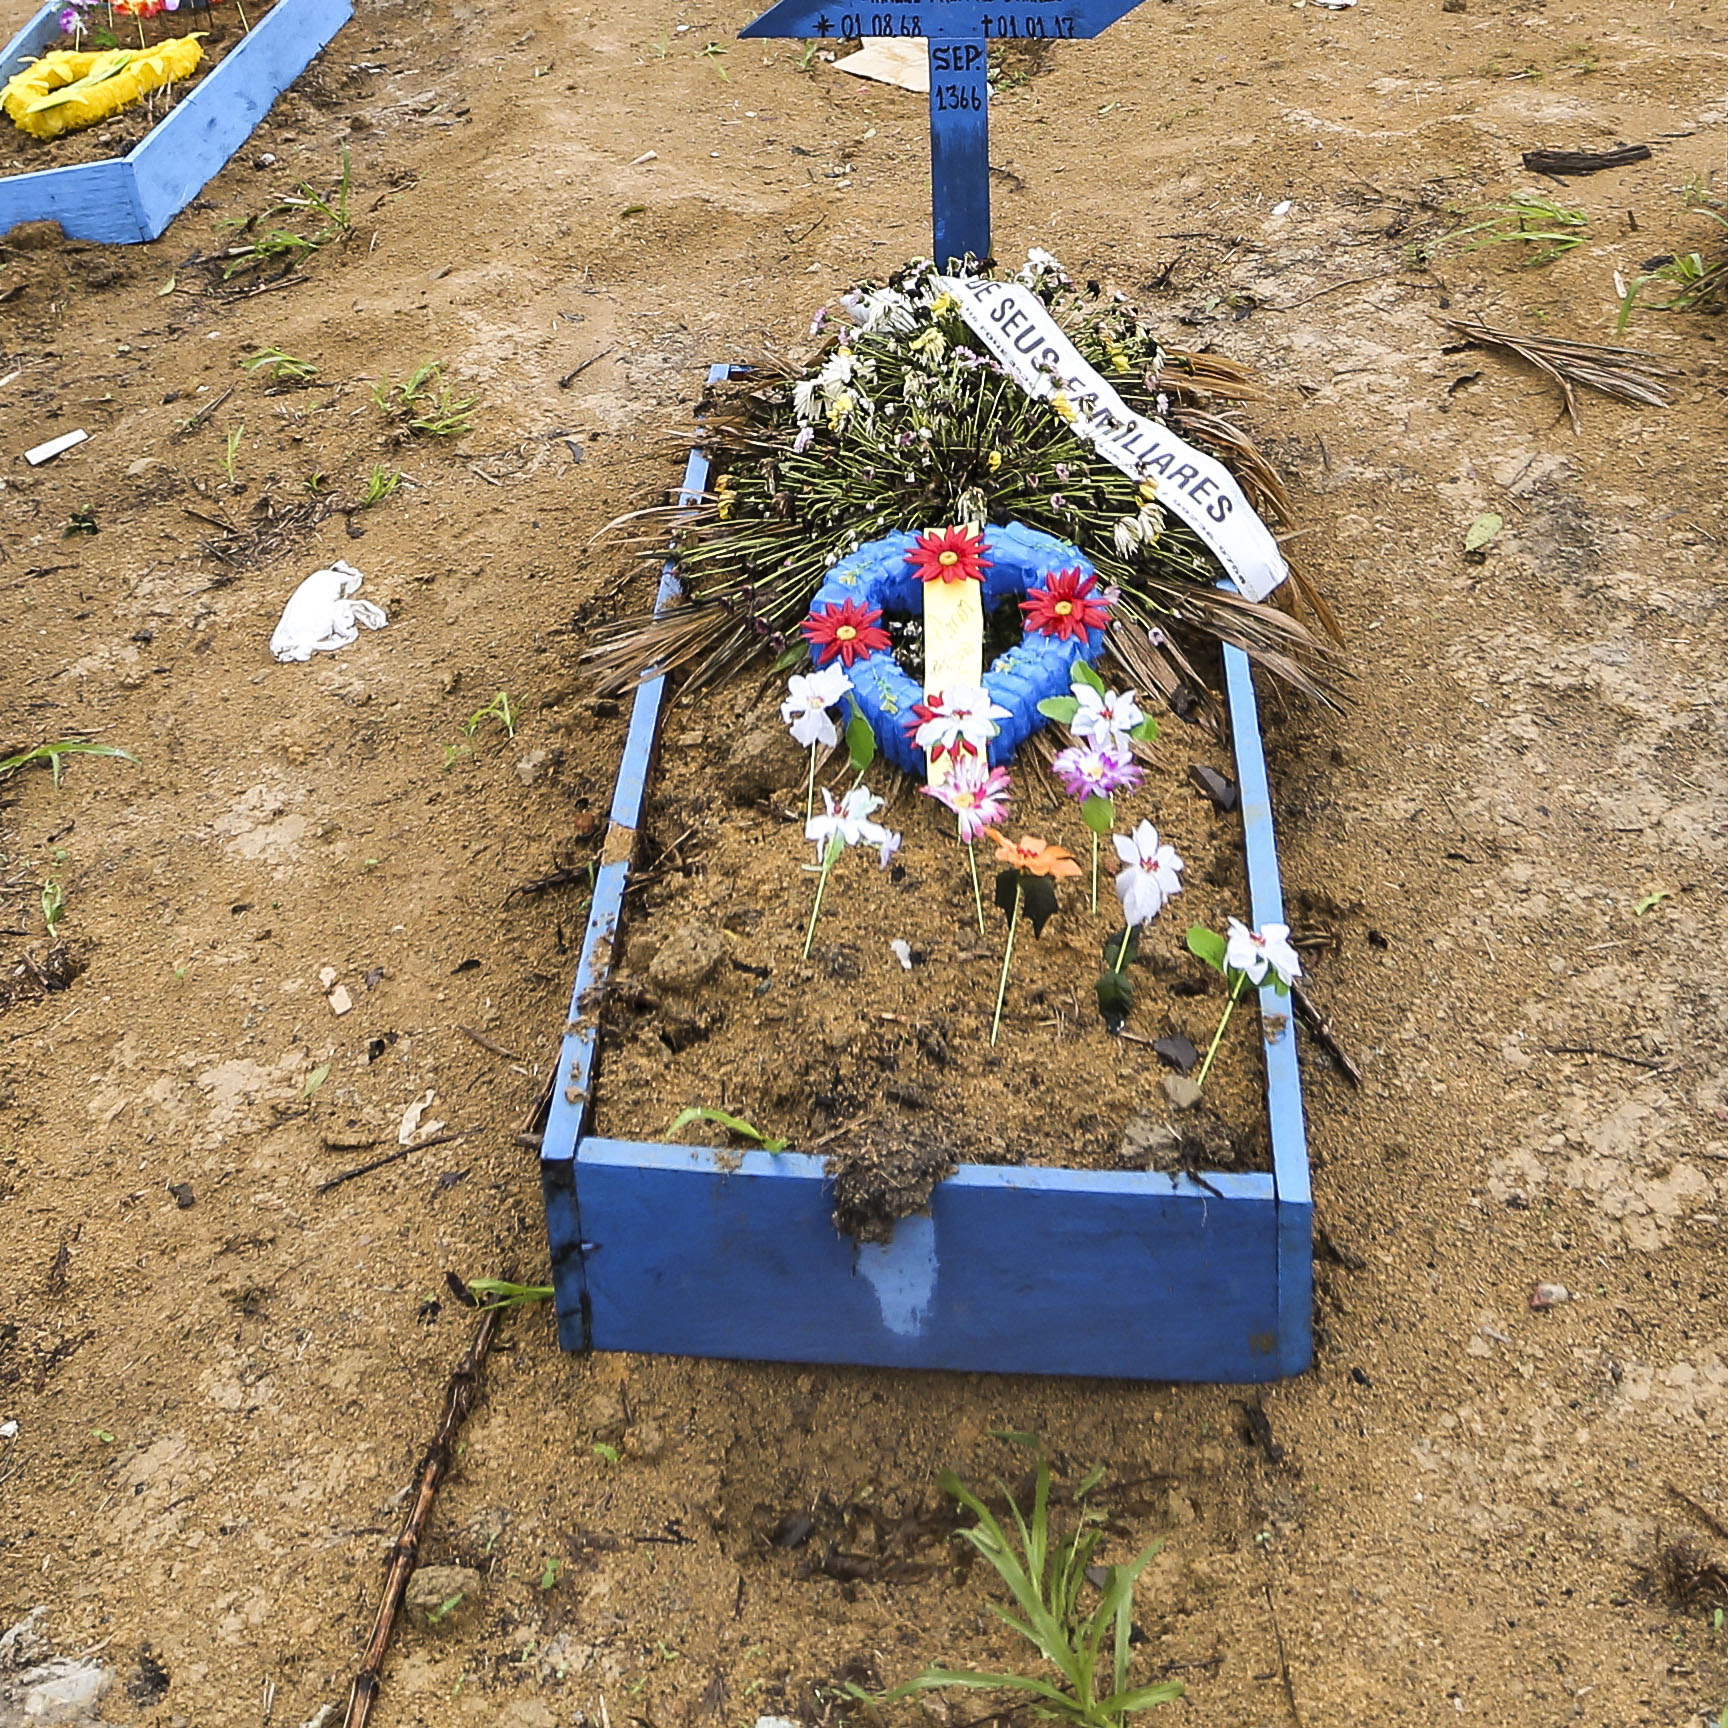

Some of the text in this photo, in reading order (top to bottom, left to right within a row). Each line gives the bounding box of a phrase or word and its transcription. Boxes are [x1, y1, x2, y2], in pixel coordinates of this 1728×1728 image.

[935, 85, 982, 111] 1366
[964, 275, 1001, 303] DE
[990, 298, 1061, 373] SEUS
[1067, 375, 1234, 523] FAMILIARES
